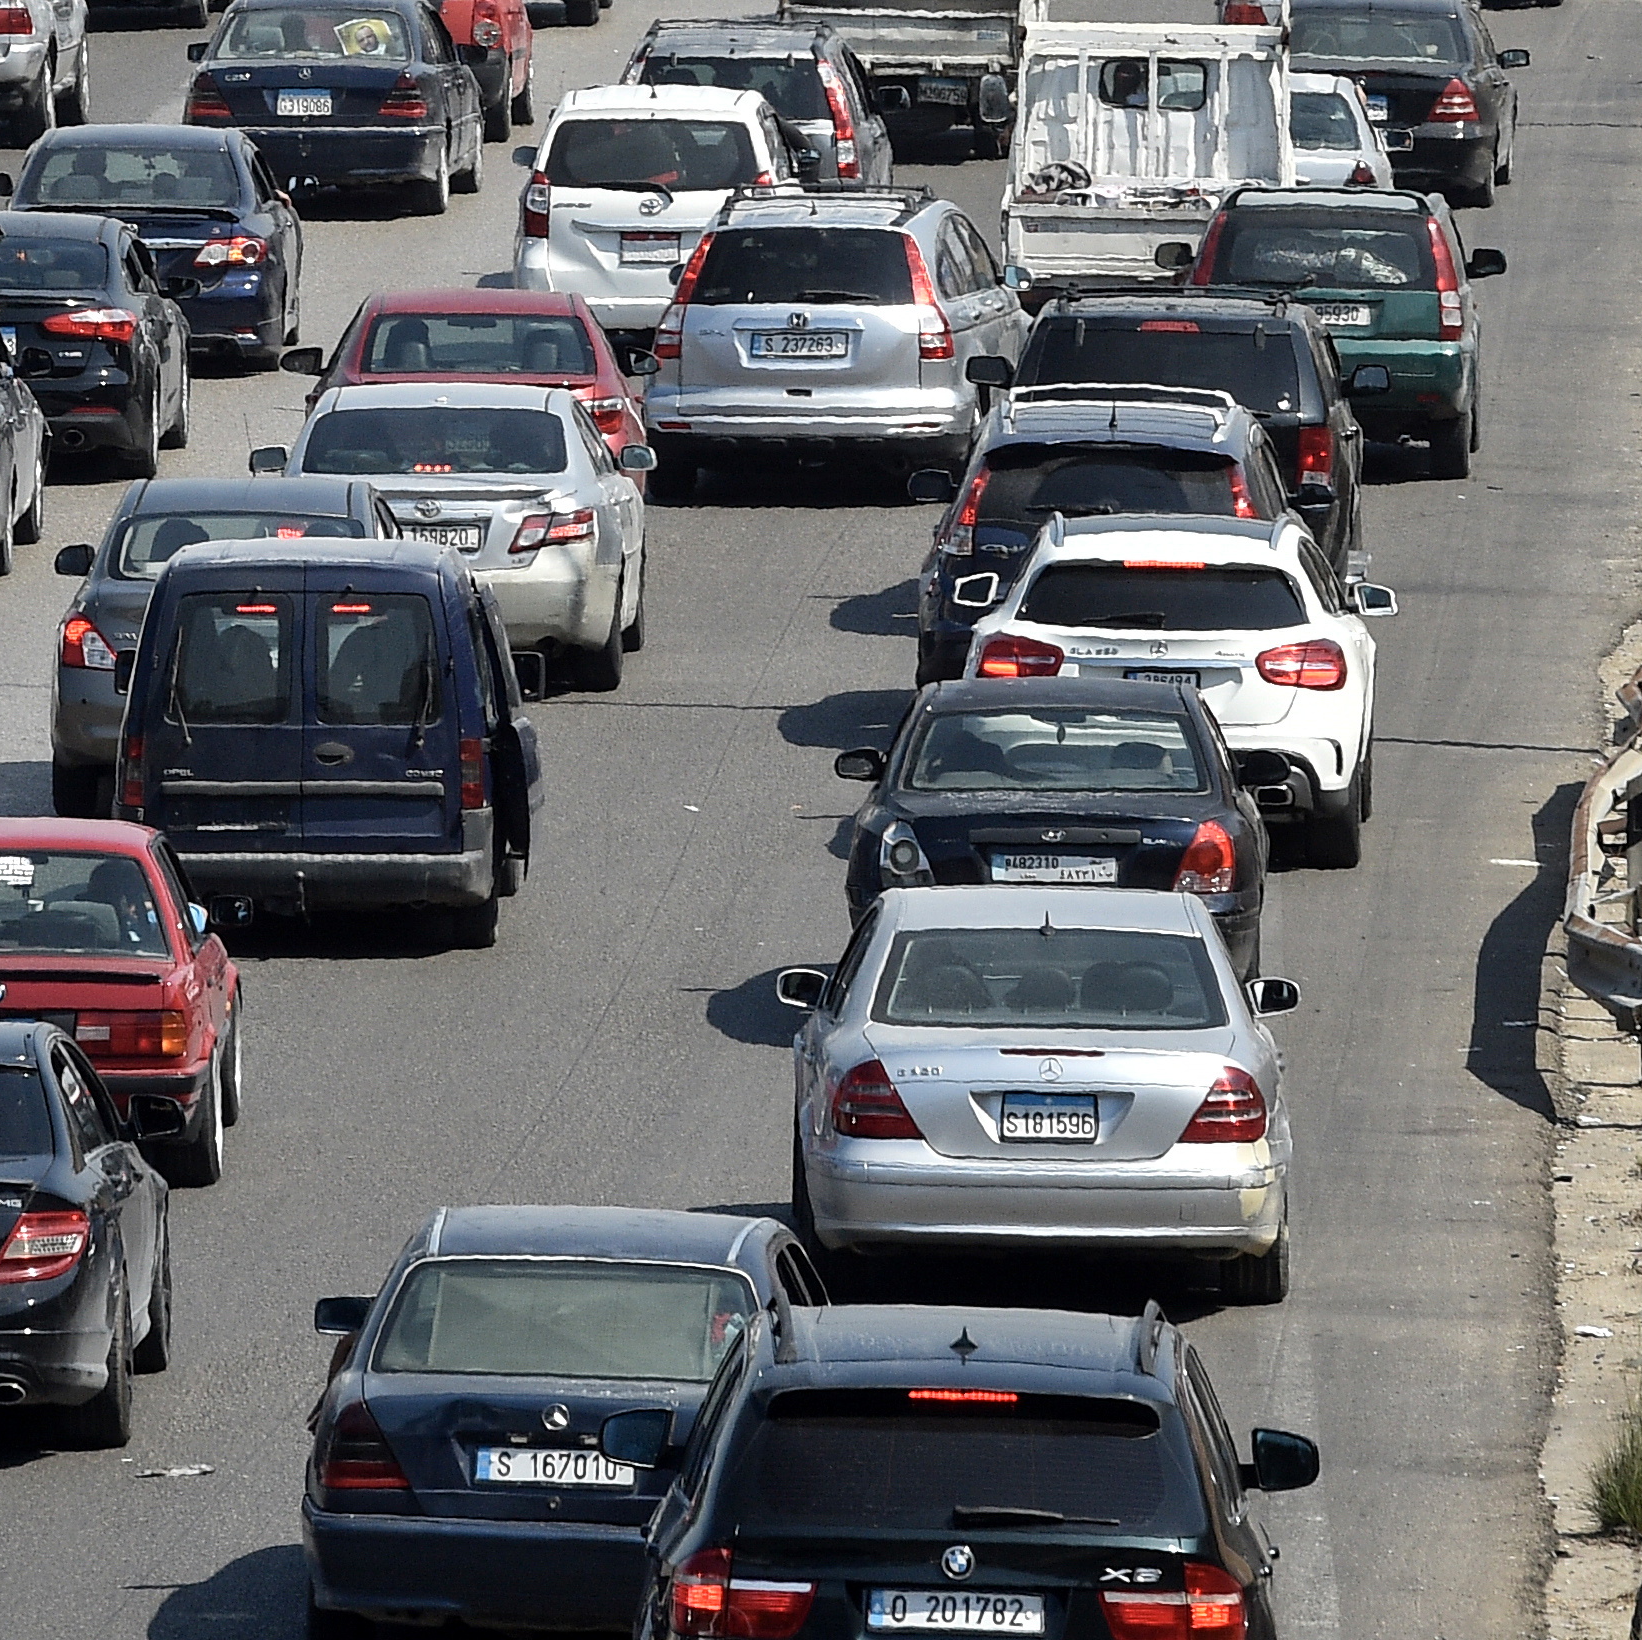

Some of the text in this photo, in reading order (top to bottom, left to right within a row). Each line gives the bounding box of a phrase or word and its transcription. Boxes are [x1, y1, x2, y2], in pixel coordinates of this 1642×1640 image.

[1314, 305, 1361, 322] 95930
[765, 336, 834, 354] S 237263
[1005, 1111, 1094, 1135] S181596
[497, 1451, 617, 1481] S 167010
[925, 1595, 1024, 1627] 201782
